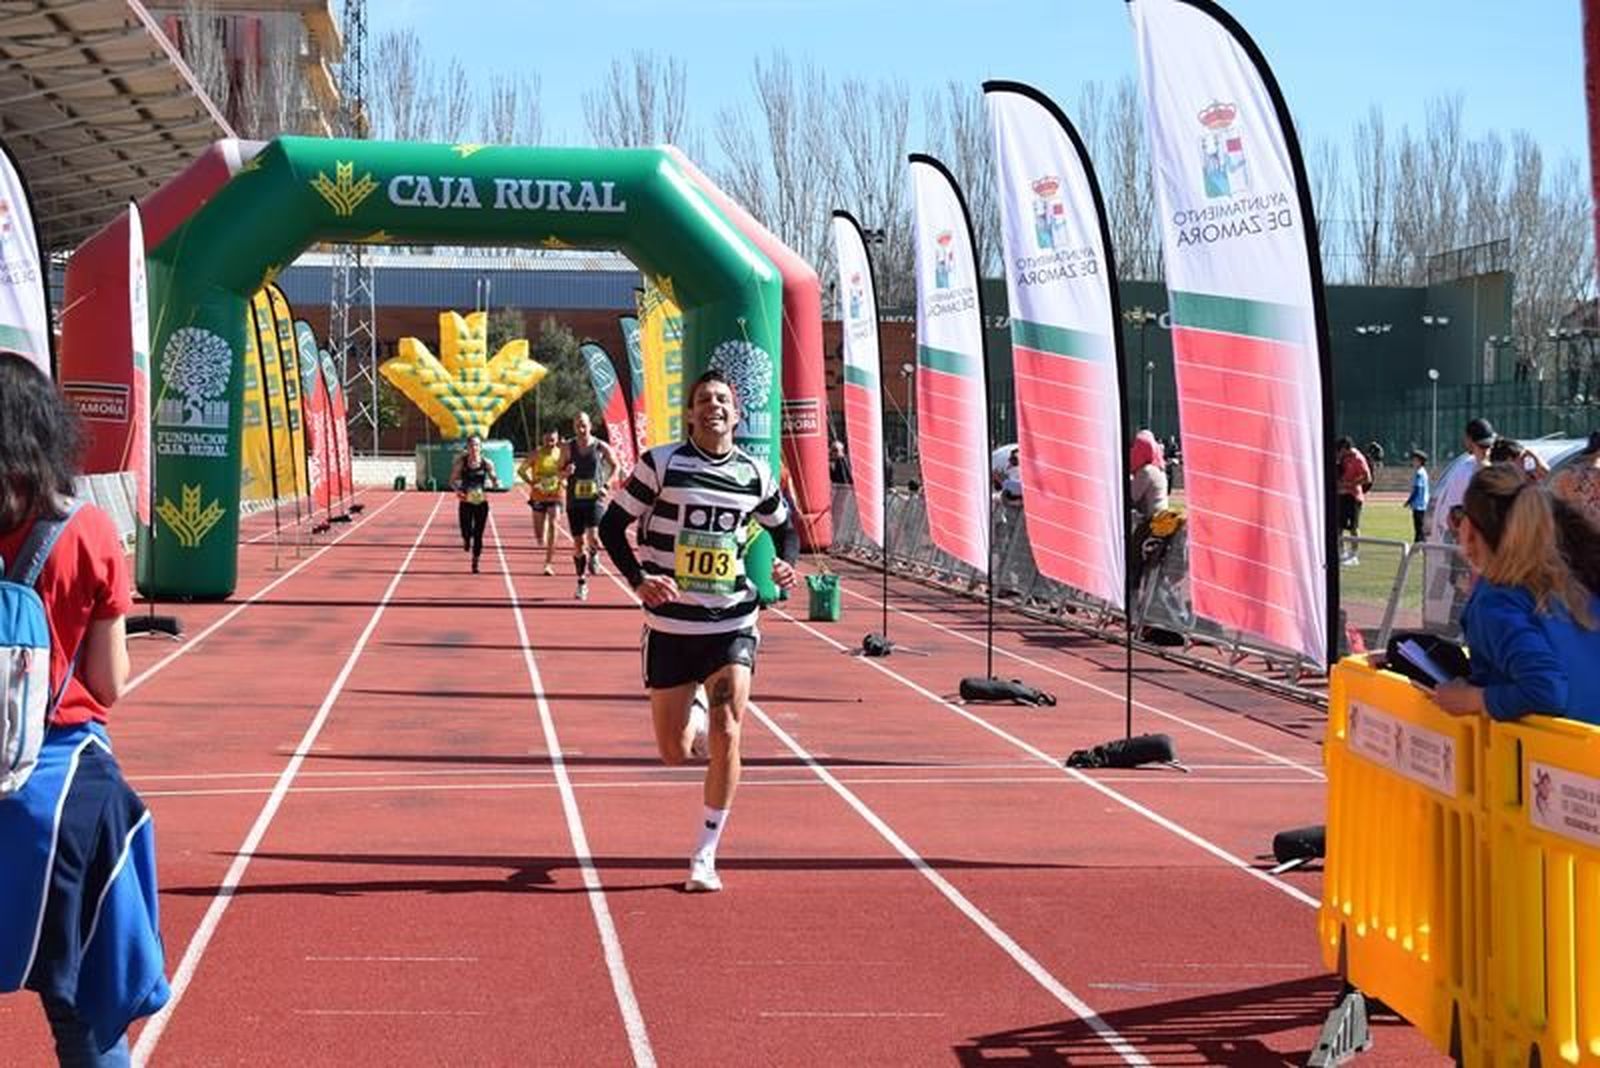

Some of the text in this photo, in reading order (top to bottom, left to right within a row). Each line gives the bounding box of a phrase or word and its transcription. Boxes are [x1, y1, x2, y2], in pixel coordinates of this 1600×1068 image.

[387, 174, 627, 213] CAJA RURAL
[79, 402, 125, 416] AMORA
[157, 443, 229, 457] CAJA RURAL
[685, 549, 730, 577] 103
